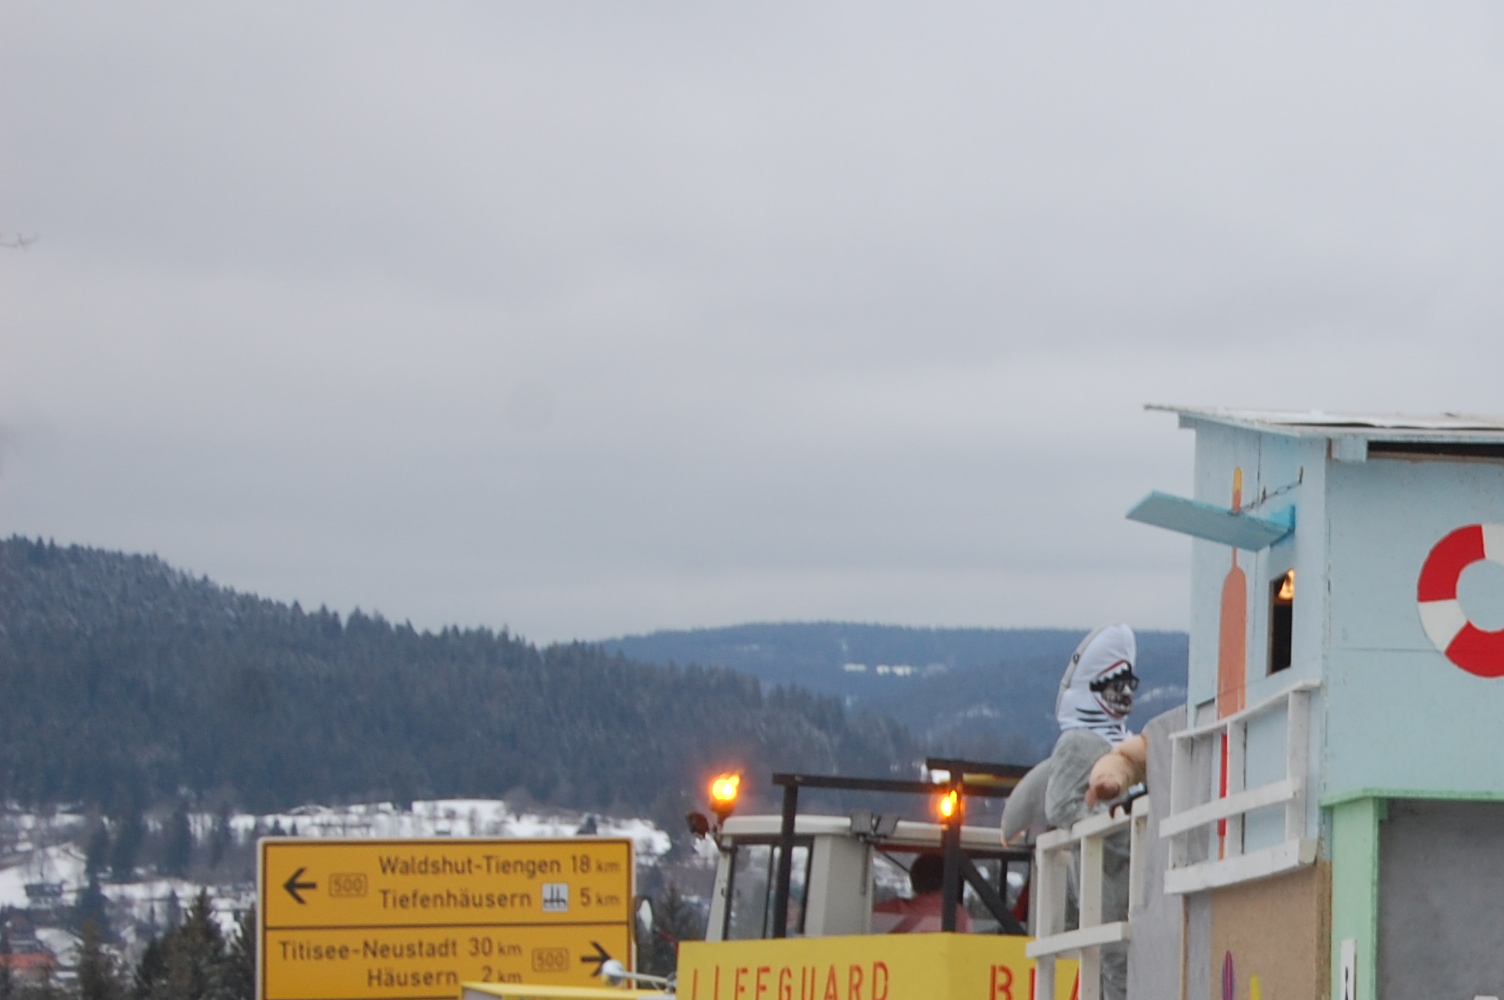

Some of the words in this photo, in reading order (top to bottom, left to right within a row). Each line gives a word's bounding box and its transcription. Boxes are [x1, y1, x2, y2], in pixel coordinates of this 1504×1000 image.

[379, 855, 562, 879] Waldshut-Tiengen
[571, 856, 591, 874] 18
[596, 861, 621, 874] km
[333, 876, 363, 895] 500
[379, 889, 532, 909] Tiefenhäusern
[580, 888, 591, 906] 5
[596, 893, 621, 906] km
[279, 938, 459, 960] Titisee-Neustadt
[468, 937, 494, 957] 30
[499, 942, 523, 957] km
[536, 951, 564, 968] 500
[366, 966, 459, 987] Häusern
[481, 967, 493, 984] 2
[498, 969, 523, 984] km
